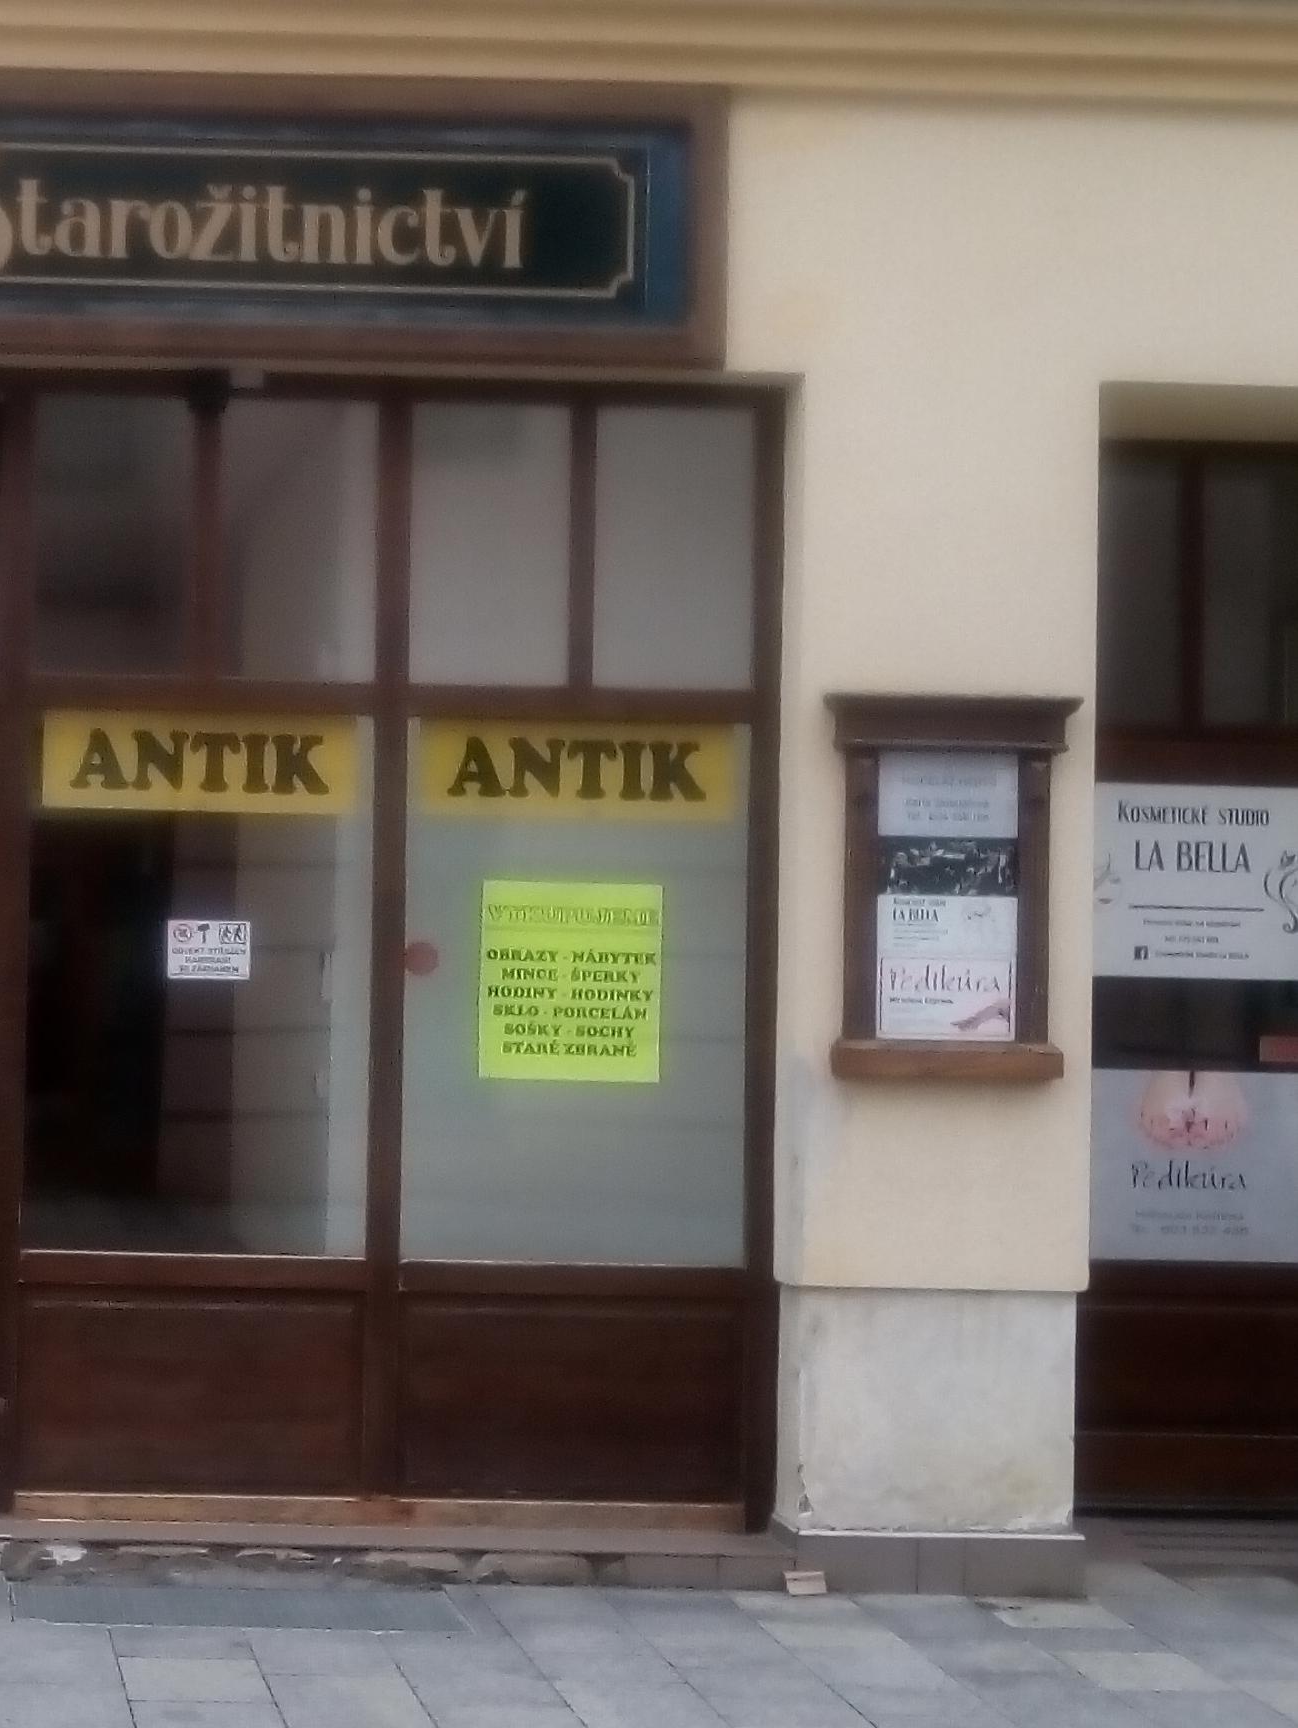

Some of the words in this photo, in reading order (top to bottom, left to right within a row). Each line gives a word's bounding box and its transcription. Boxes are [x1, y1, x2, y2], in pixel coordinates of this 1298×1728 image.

[70, 727, 330, 796] ANTIK
[447, 735, 707, 803] ANTIK
[1118, 799, 1208, 826] KOSMETICKÉ
[1219, 808, 1270, 827] STUDIO
[1134, 839, 1165, 872] LA
[1176, 840, 1251, 874] BELLA
[486, 948, 559, 963] OBRAZY
[571, 948, 657, 966] NÁBYTEK
[502, 968, 559, 982] MINCE
[487, 984, 558, 1000] HODINY
[570, 989, 654, 1002] HODINKY
[492, 1003, 540, 1017] SKLO
[553, 1005, 648, 1021] PORCELÁN
[574, 1024, 635, 1039] SOCHY
[501, 1038, 560, 1056] STARÉ
